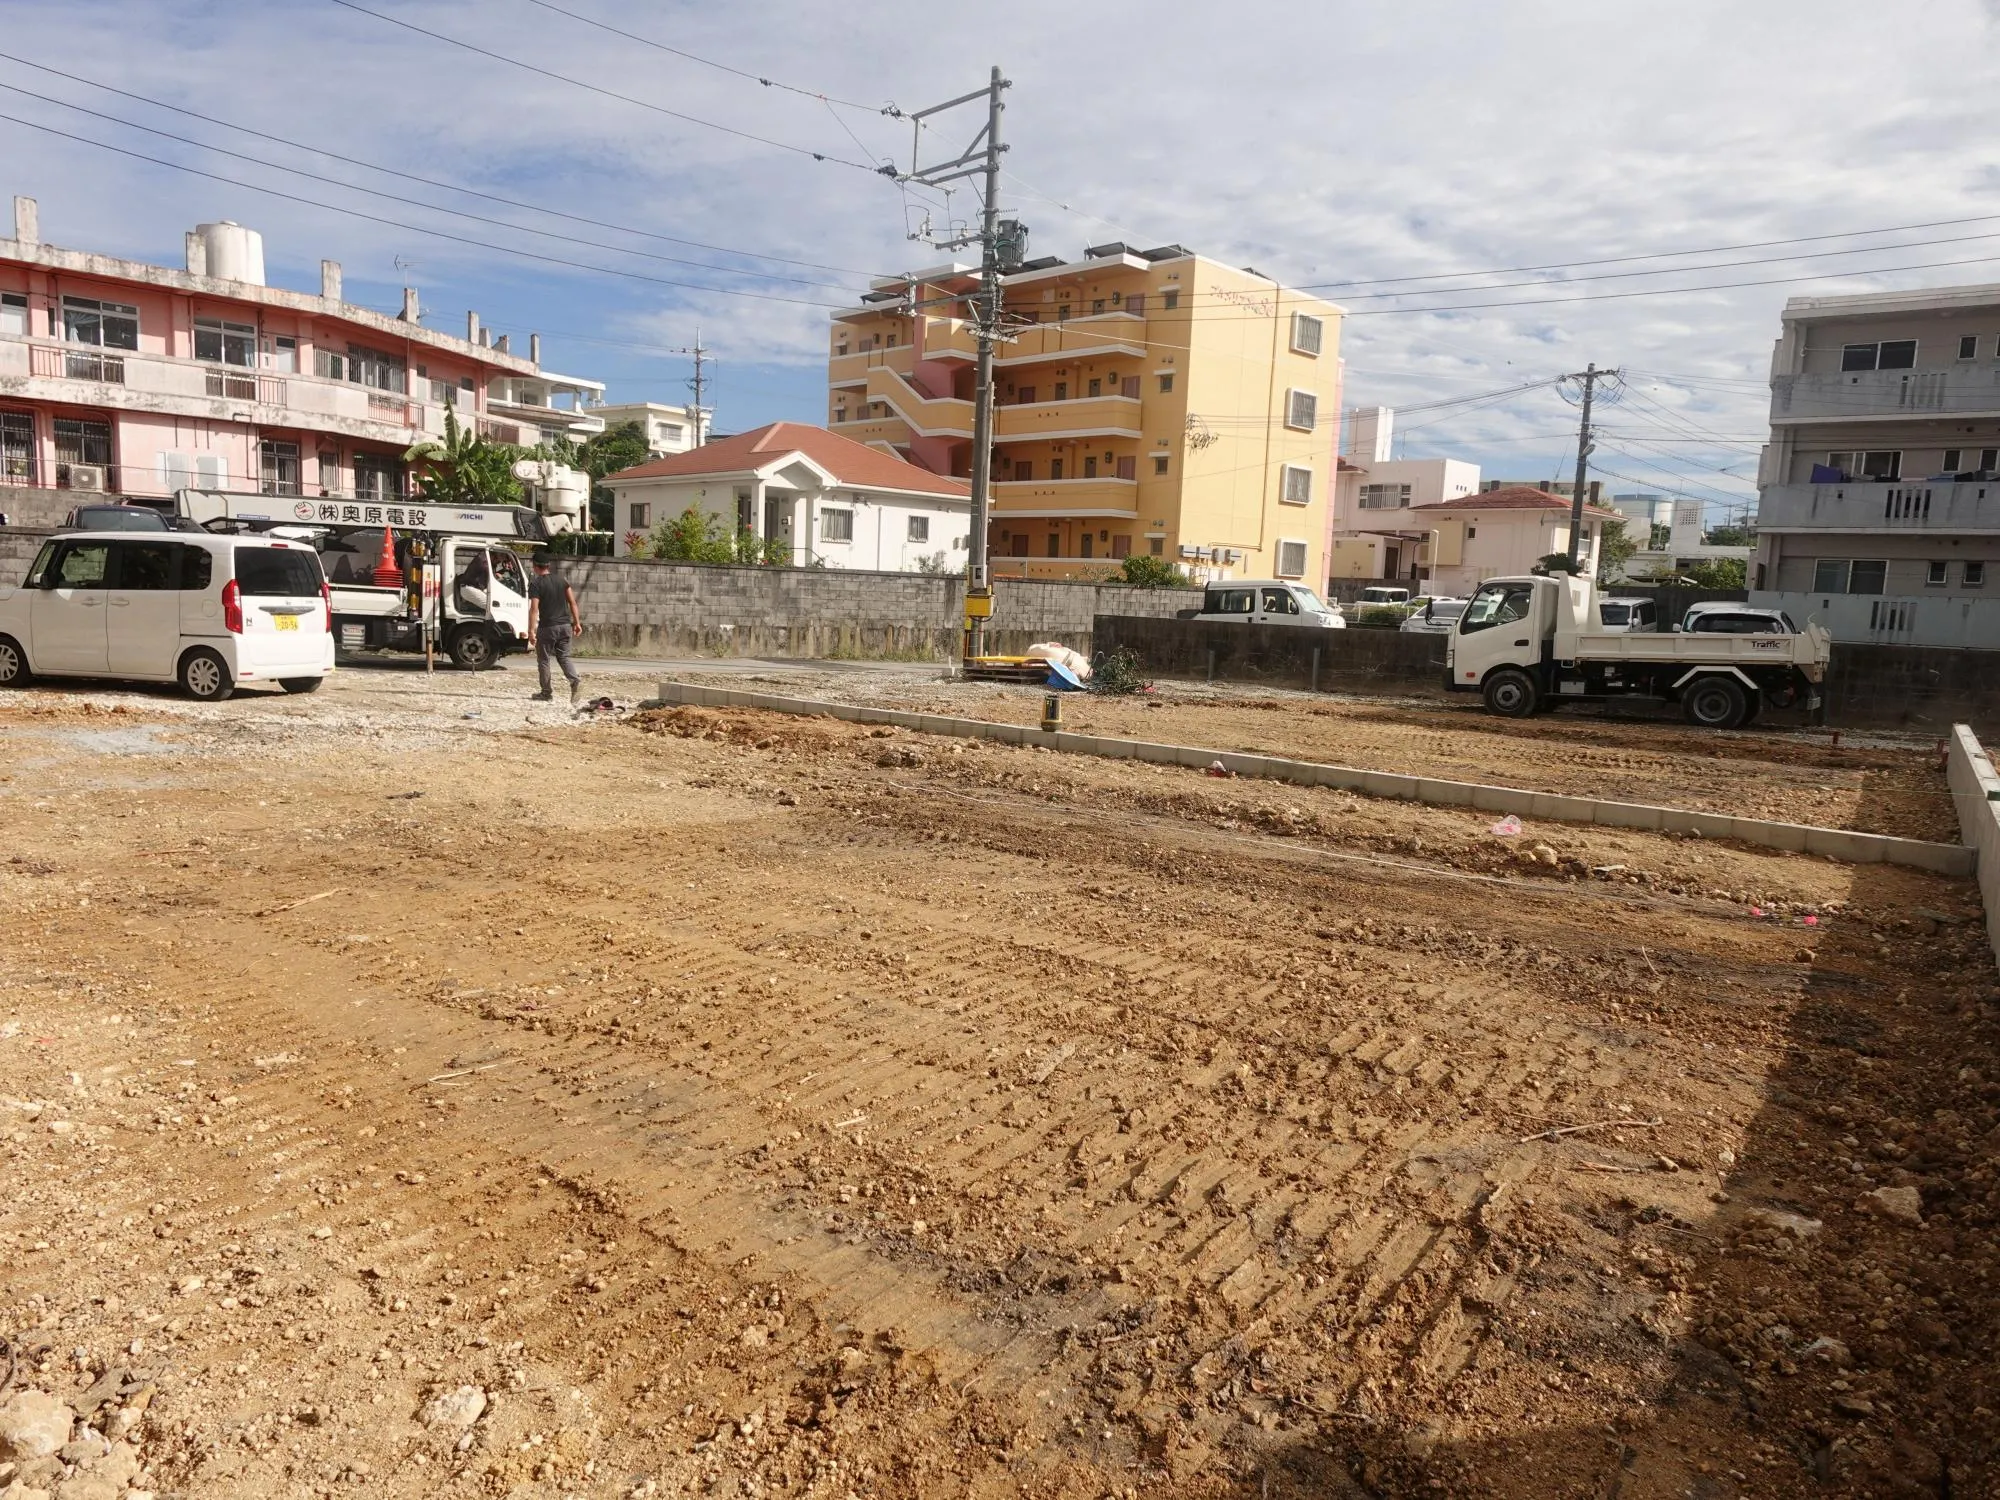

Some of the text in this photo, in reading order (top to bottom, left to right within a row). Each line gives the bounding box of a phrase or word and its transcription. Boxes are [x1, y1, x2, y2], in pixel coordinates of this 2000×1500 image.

[318, 504, 427, 527] (株)奥原電設
[1751, 640, 1781, 649] Traffic
